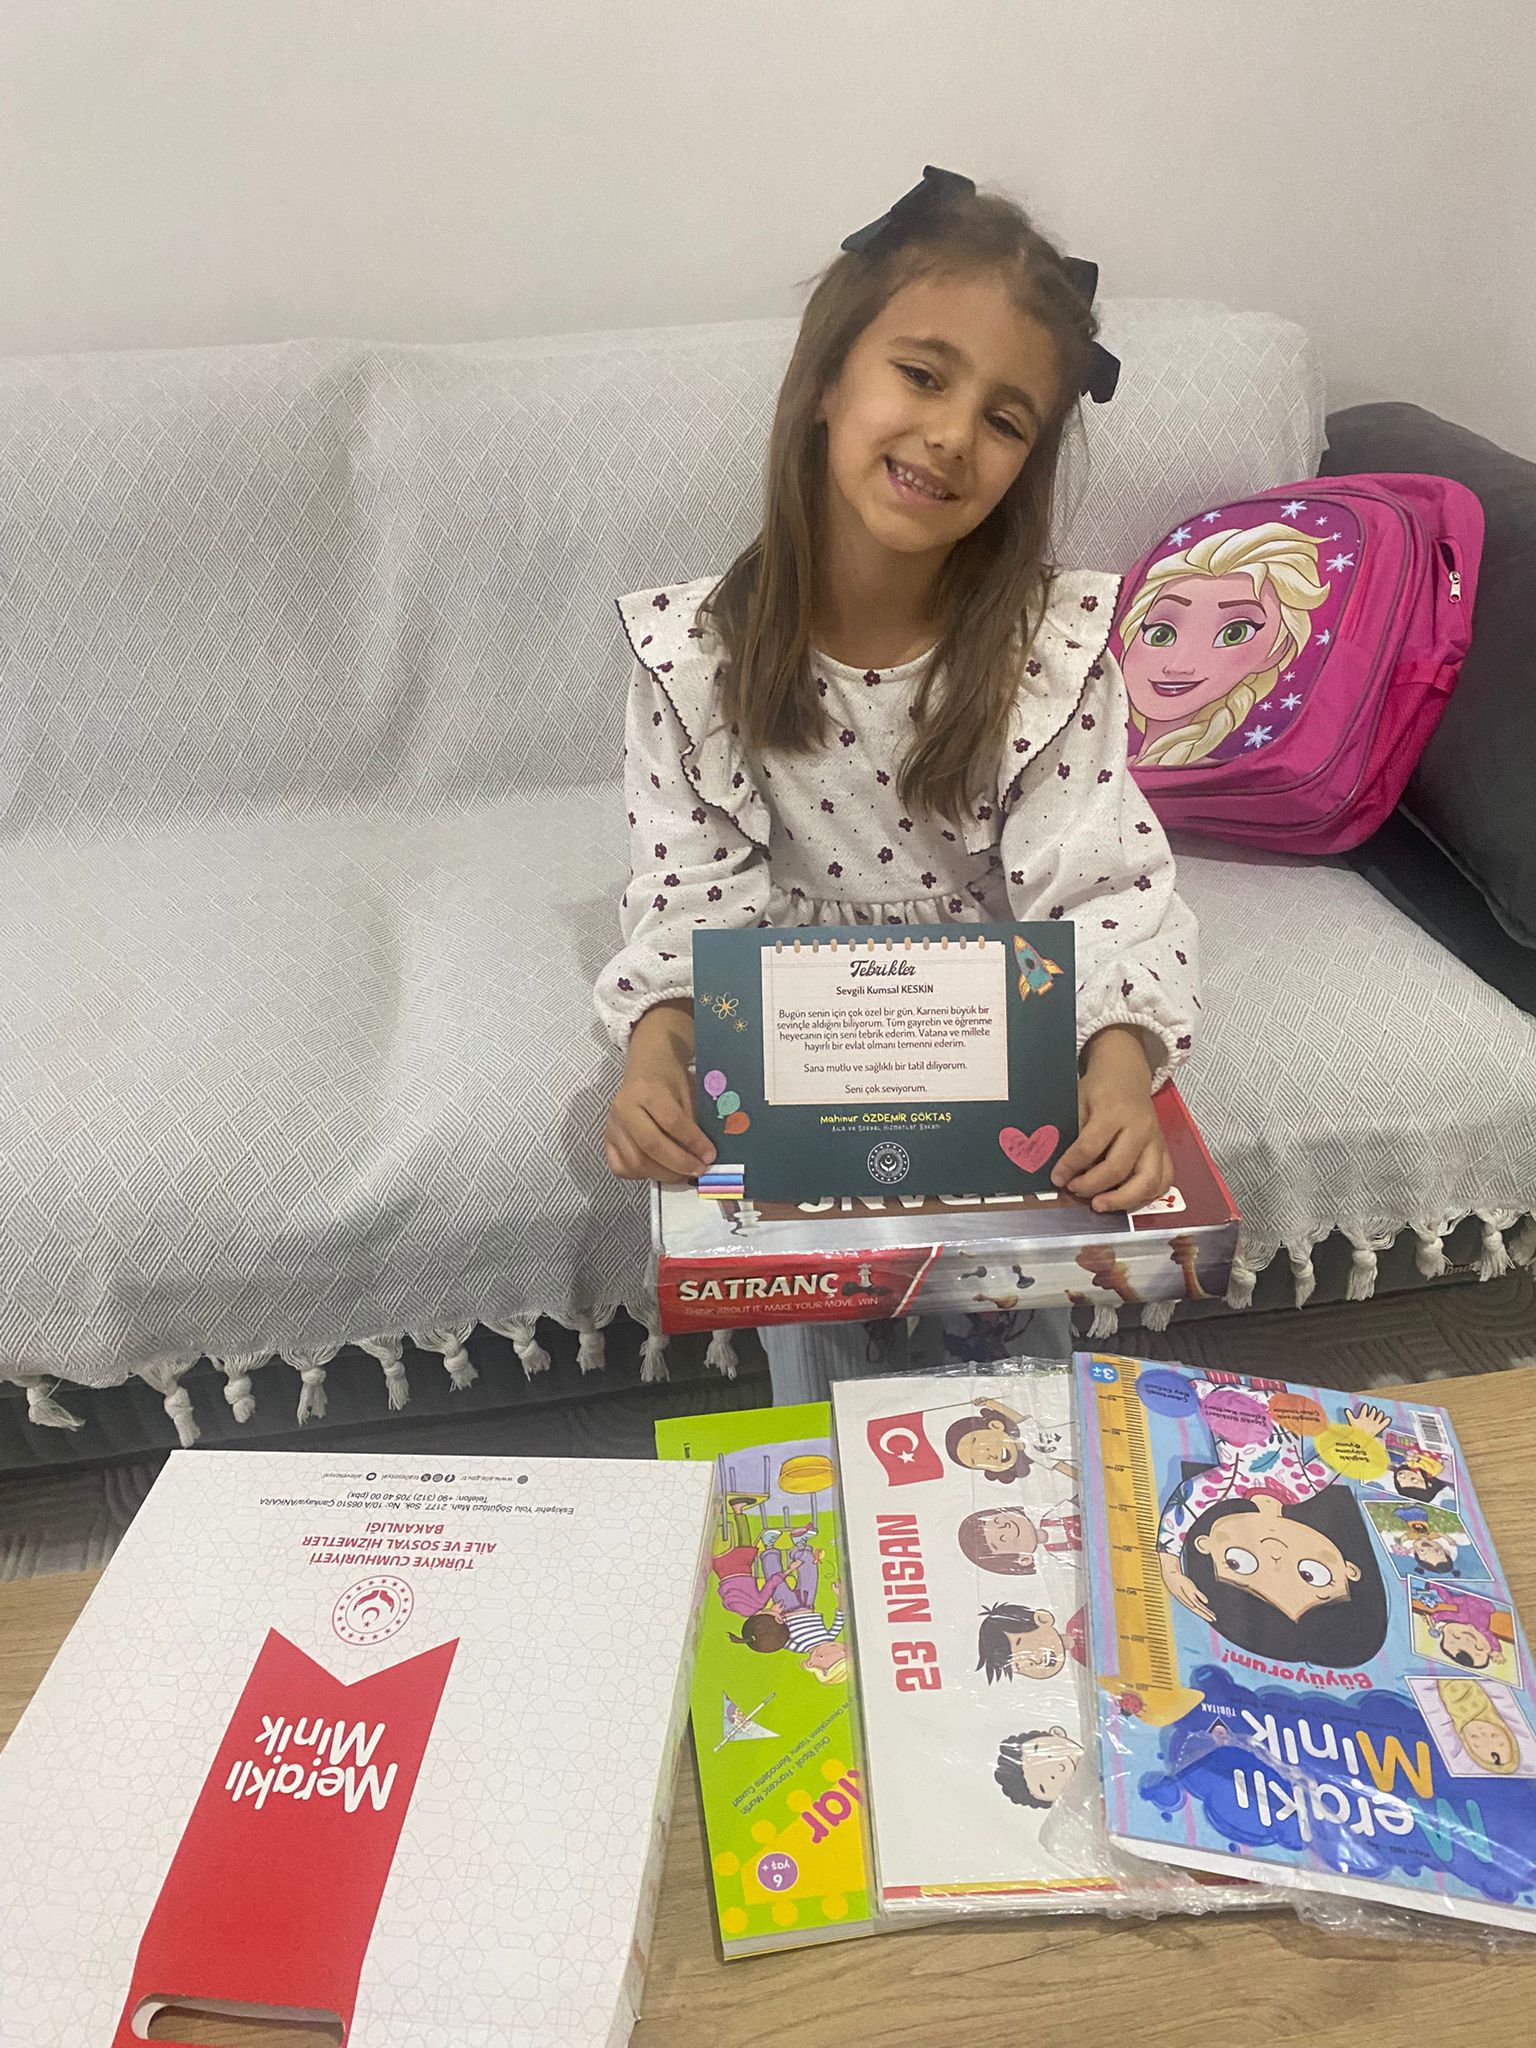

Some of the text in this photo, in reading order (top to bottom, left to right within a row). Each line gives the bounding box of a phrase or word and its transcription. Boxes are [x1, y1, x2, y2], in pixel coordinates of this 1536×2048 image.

[850, 959, 916, 978] Tebrikler
[836, 986, 865, 997] Sevgili
[867, 985, 899, 995] Kumsal
[779, 1009, 806, 1020] Bugün
[808, 1010, 830, 1018] senin
[832, 1009, 846, 1019] için
[848, 1008, 863, 1019] çok
[865, 1008, 882, 1017] özel
[884, 1008, 895, 1016] bir
[917, 1006, 949, 1015] Karneni
[951, 1005, 977, 1016] büyük
[978, 1005, 990, 1014] bir
[777, 1020, 810, 1031] sevinçle
[812, 1019, 842, 1030] aldığını
[886, 1017, 906, 1027] Tüm
[907, 1017, 941, 1029] gayretin
[955, 1016, 992, 1028] öğrenme
[780, 1031, 822, 1042] heyecanın
[824, 1031, 838, 1041] için
[840, 1030, 857, 1039] seni
[858, 1029, 883, 1039] tebrik
[918, 1028, 947, 1037] Vatana
[949, 1029, 960, 1037] ve
[961, 1027, 990, 1036] millete
[804, 1042, 830, 1053] hayırlı
[832, 1041, 843, 1051] bir
[845, 1040, 866, 1050] evlat
[867, 1039, 896, 1049] olmanı
[898, 1039, 932, 1048] temenni
[803, 1060, 968, 1074] Sana mutlu ve sağlıklı bir tatil diliyorum.
[845, 1083, 928, 1095] Seni çok seviyorum.
[820, 1111, 952, 1125] Mahinur ÖZDEMİR GÖKTAŞ
[679, 1272, 839, 1302] SATRANÇ
[764, 1303, 794, 1312] MAKE
[795, 1301, 823, 1311] YOUR
[858, 1297, 879, 1306] WIN
[259, 1498, 336, 1508] Çankaya/ANKARA
[337, 1500, 364, 1510] 06510
[346, 1491, 489, 1504] Telefon: +90 (312) 705 40 00 (pbx)
[364, 1500, 383, 1510] 10/A
[384, 1500, 401, 1510] No:
[449, 1503, 471, 1512] Mah.
[472, 1503, 513, 1514] Söğütözü
[514, 1505, 533, 1514] Yolu
[534, 1505, 575, 1515] Eskişehir
[364, 1521, 445, 1535] BAKANLIĞI
[301, 1536, 497, 1556] AİLE VE SOSYAL HİZMETLER
[309, 1552, 474, 1572] TÜRKİYE CUMHURİYETİ
[876, 1514, 942, 1692] 23 NİSAN
[1220, 1648, 1374, 1691] Büyüyorum!
[1200, 1702, 1238, 1718] TÜBİTAK
[254, 1715, 386, 1768] Minik
[793, 1748, 817, 1769] Ripoll
[224, 1759, 399, 1814] Meraklı
[761, 1767, 795, 1797] Francesc
[801, 1770, 862, 1844] lar
[1232, 1768, 1494, 1865] Meraklı
[770, 1859, 791, 1871] yaş
[772, 1873, 783, 1888] 6
